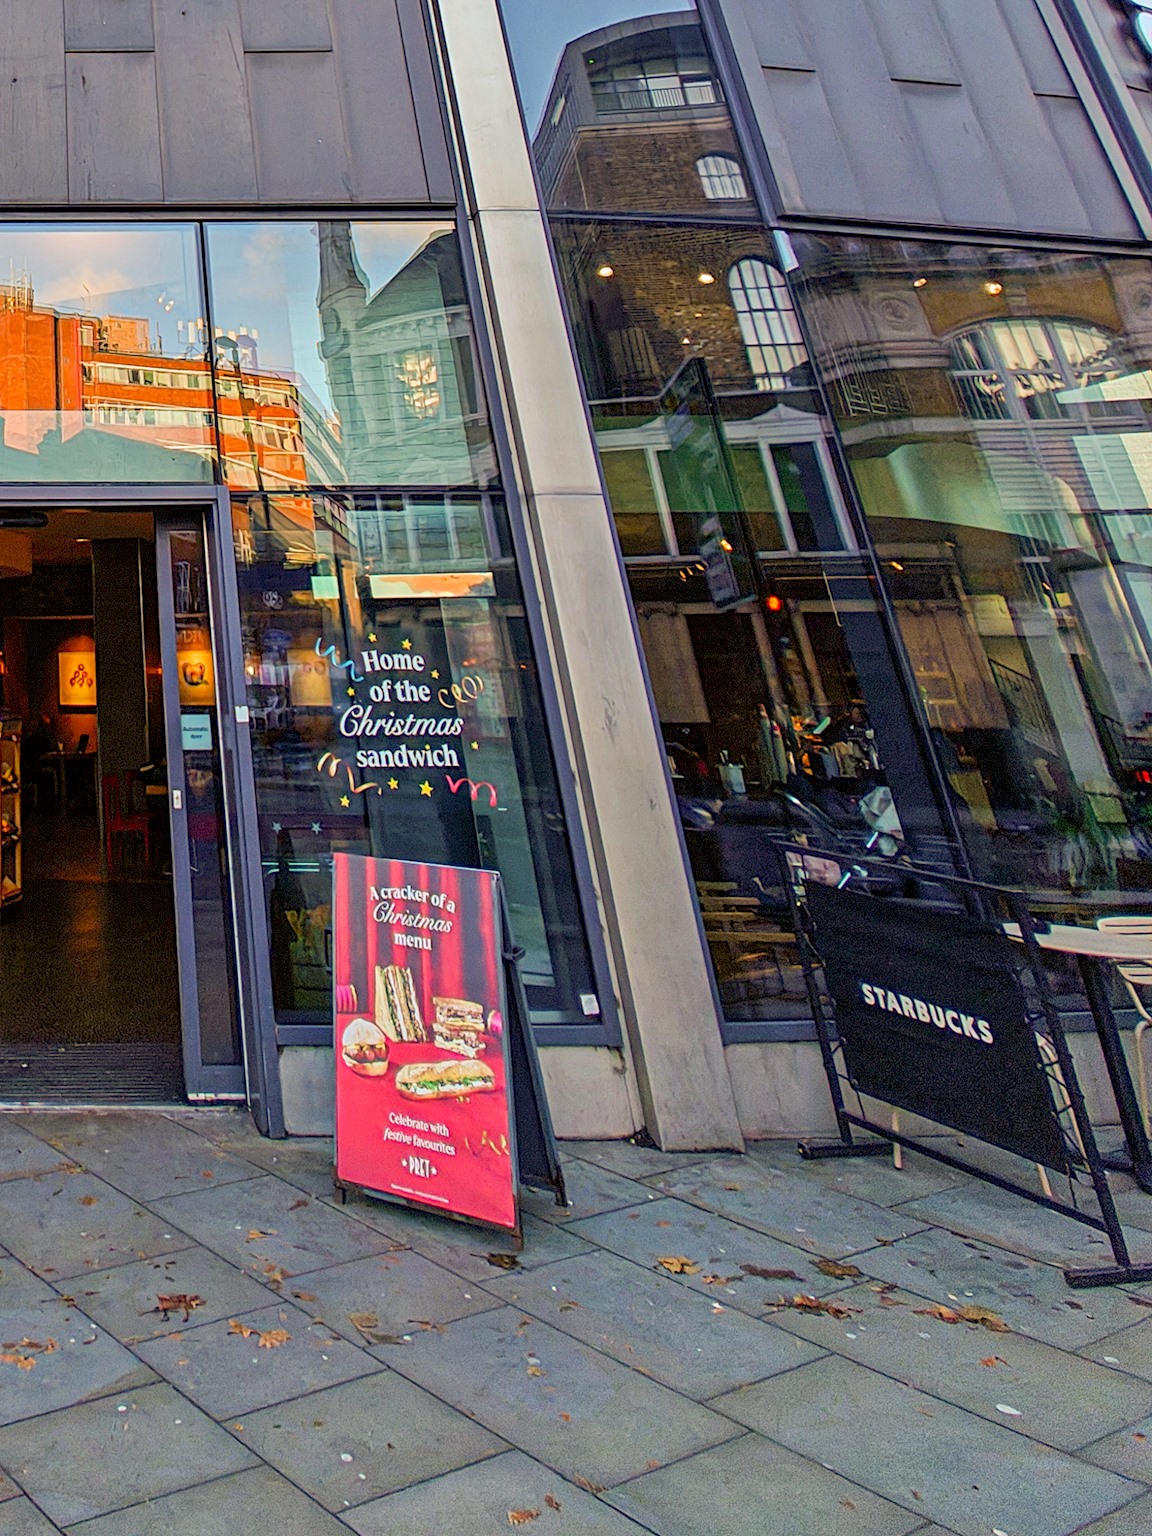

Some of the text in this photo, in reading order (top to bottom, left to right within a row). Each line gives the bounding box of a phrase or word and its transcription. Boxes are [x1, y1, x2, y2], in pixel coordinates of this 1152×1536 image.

[361, 650, 425, 673] Home
[369, 679, 431, 702] of the
[339, 704, 464, 737] Christmas
[356, 744, 460, 768] sandwich
[370, 885, 456, 913] A cracker of a
[372, 901, 453, 933] Christmas
[394, 933, 433, 951] menu
[861, 983, 994, 1045] STARBUCKS
[389, 1112, 449, 1137] Celebrate with
[383, 1126, 456, 1155] festive favourites
[409, 1156, 430, 1178] PRET
